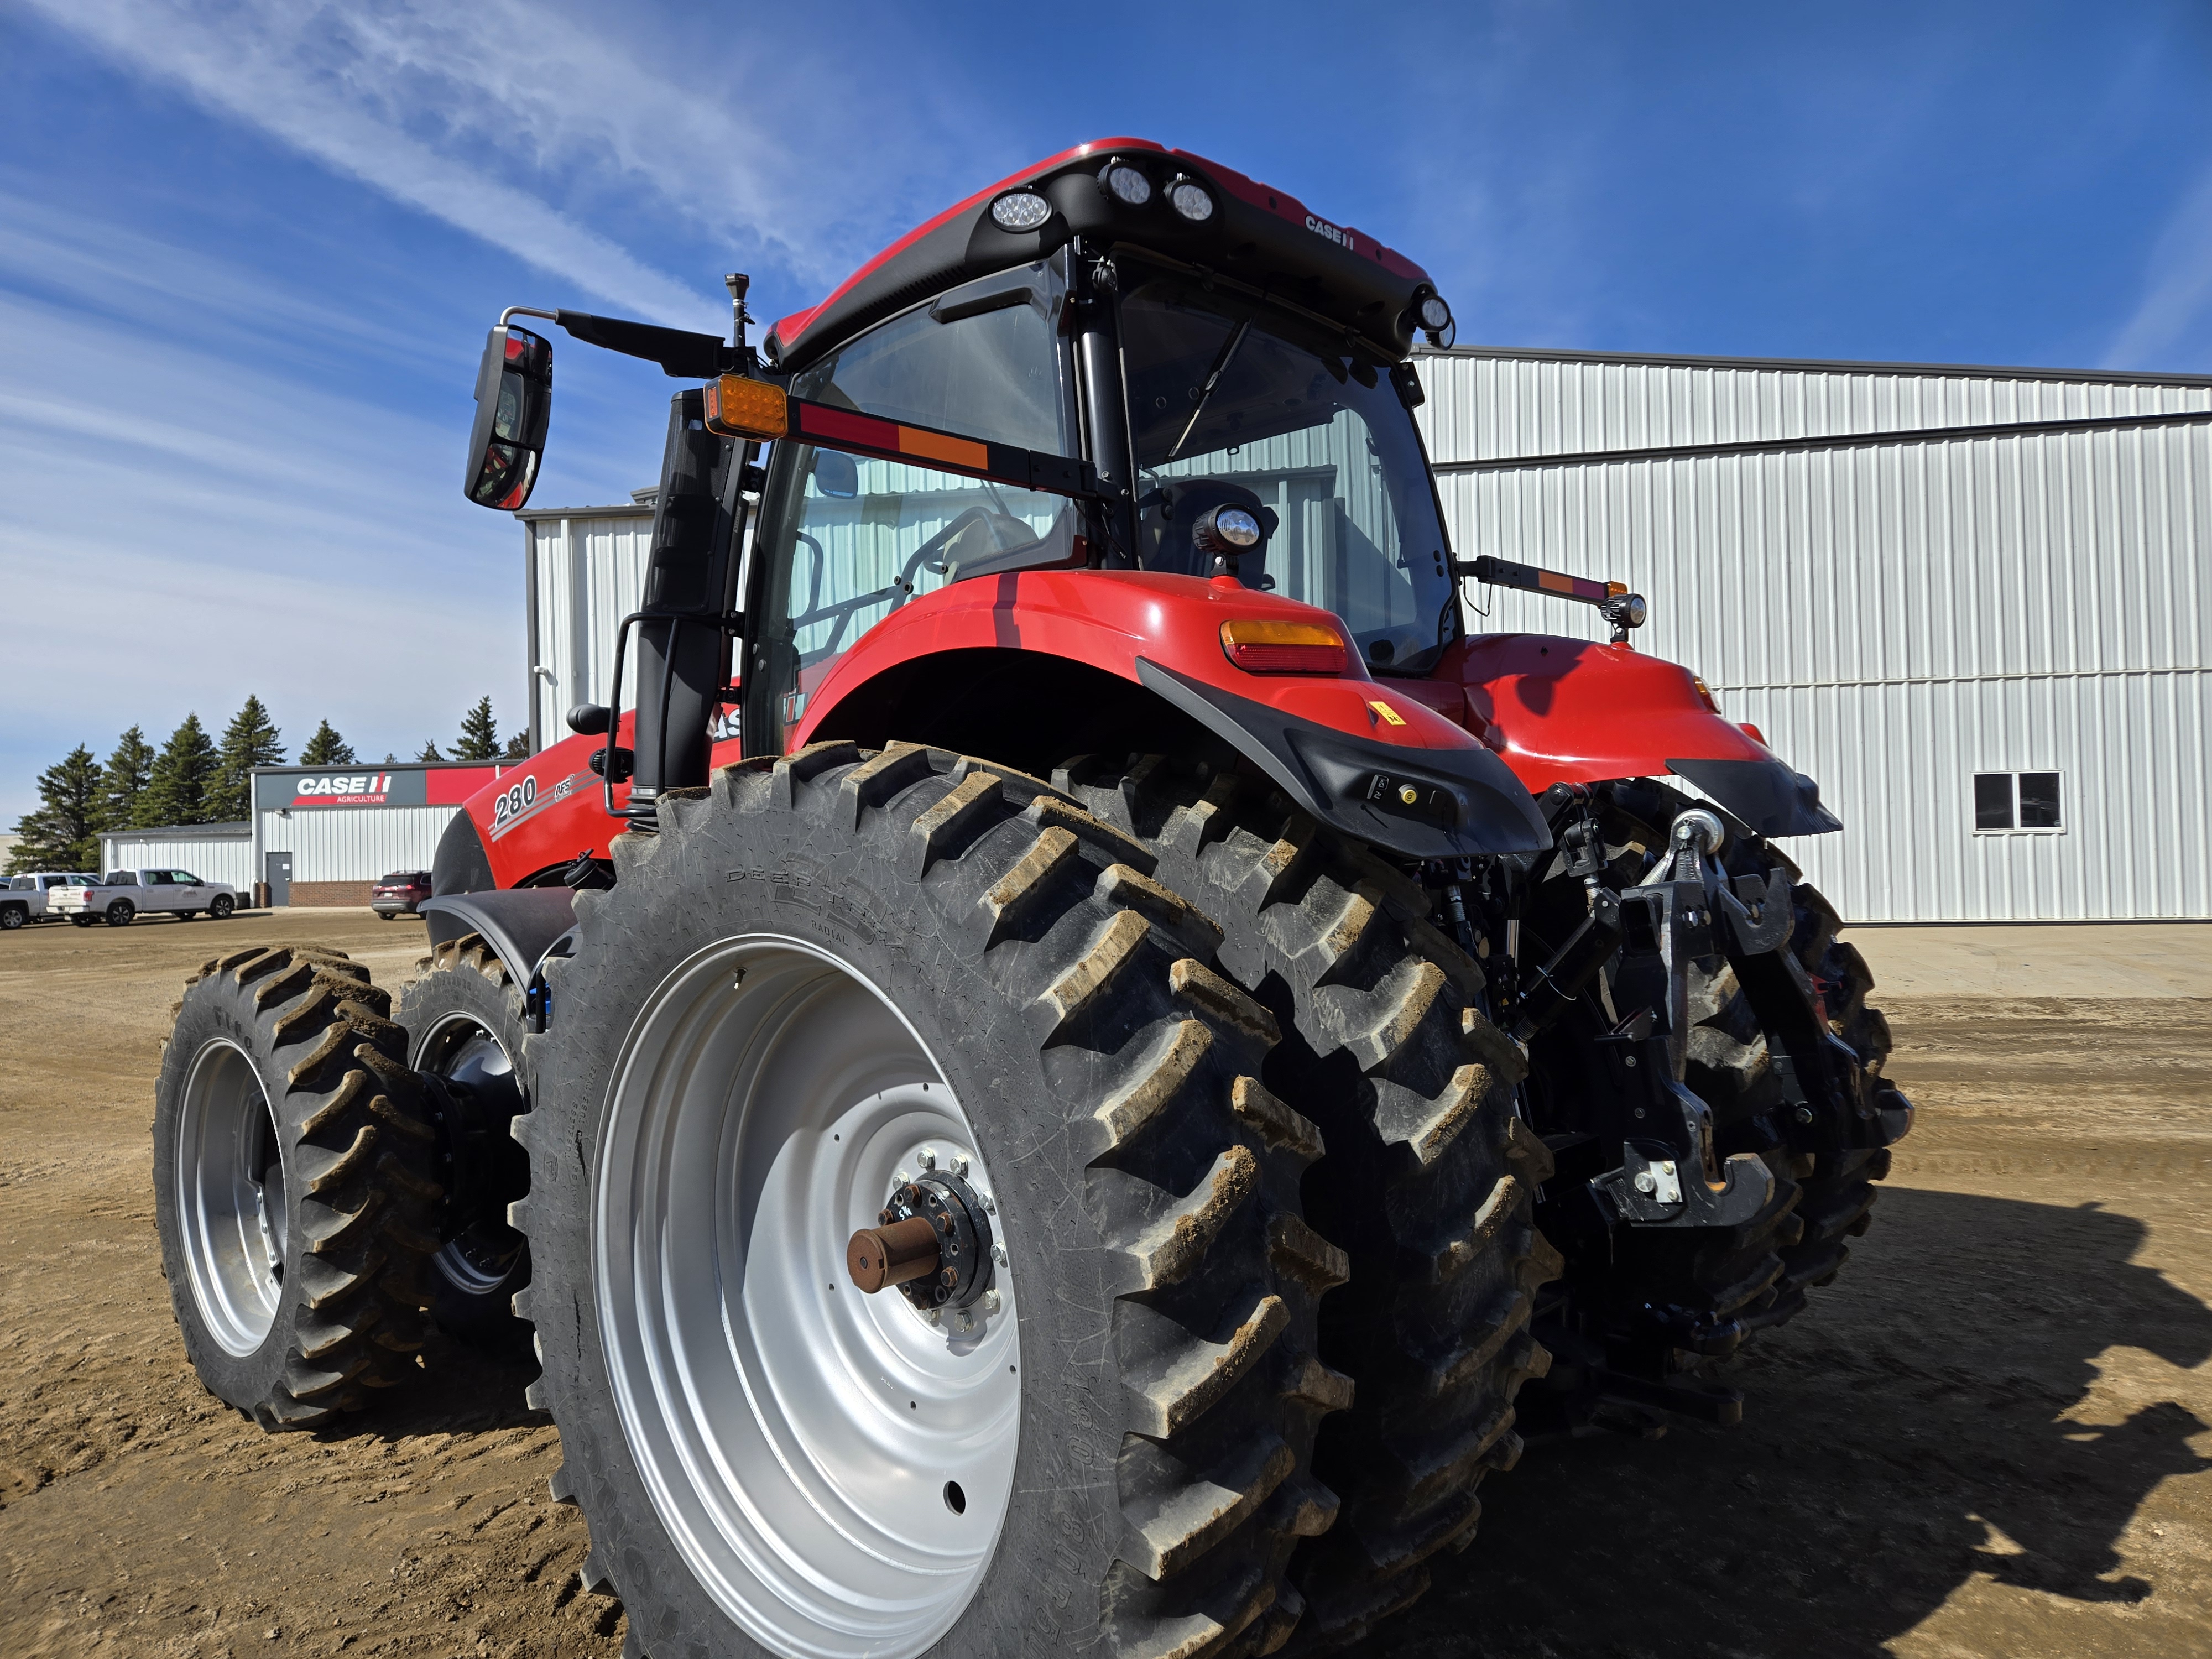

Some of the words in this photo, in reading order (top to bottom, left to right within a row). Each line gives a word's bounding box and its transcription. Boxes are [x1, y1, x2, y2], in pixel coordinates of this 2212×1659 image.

[1305, 215, 1342, 244] CASE
[296, 777, 367, 795] CASE
[554, 778, 571, 798] AFS
[495, 775, 536, 828] 280
[811, 920, 849, 946] RADIAL
[578, 1095, 589, 1124] TUBE
[586, 1066, 597, 1091] TYPE
[565, 1101, 578, 1159] TUBELESS
